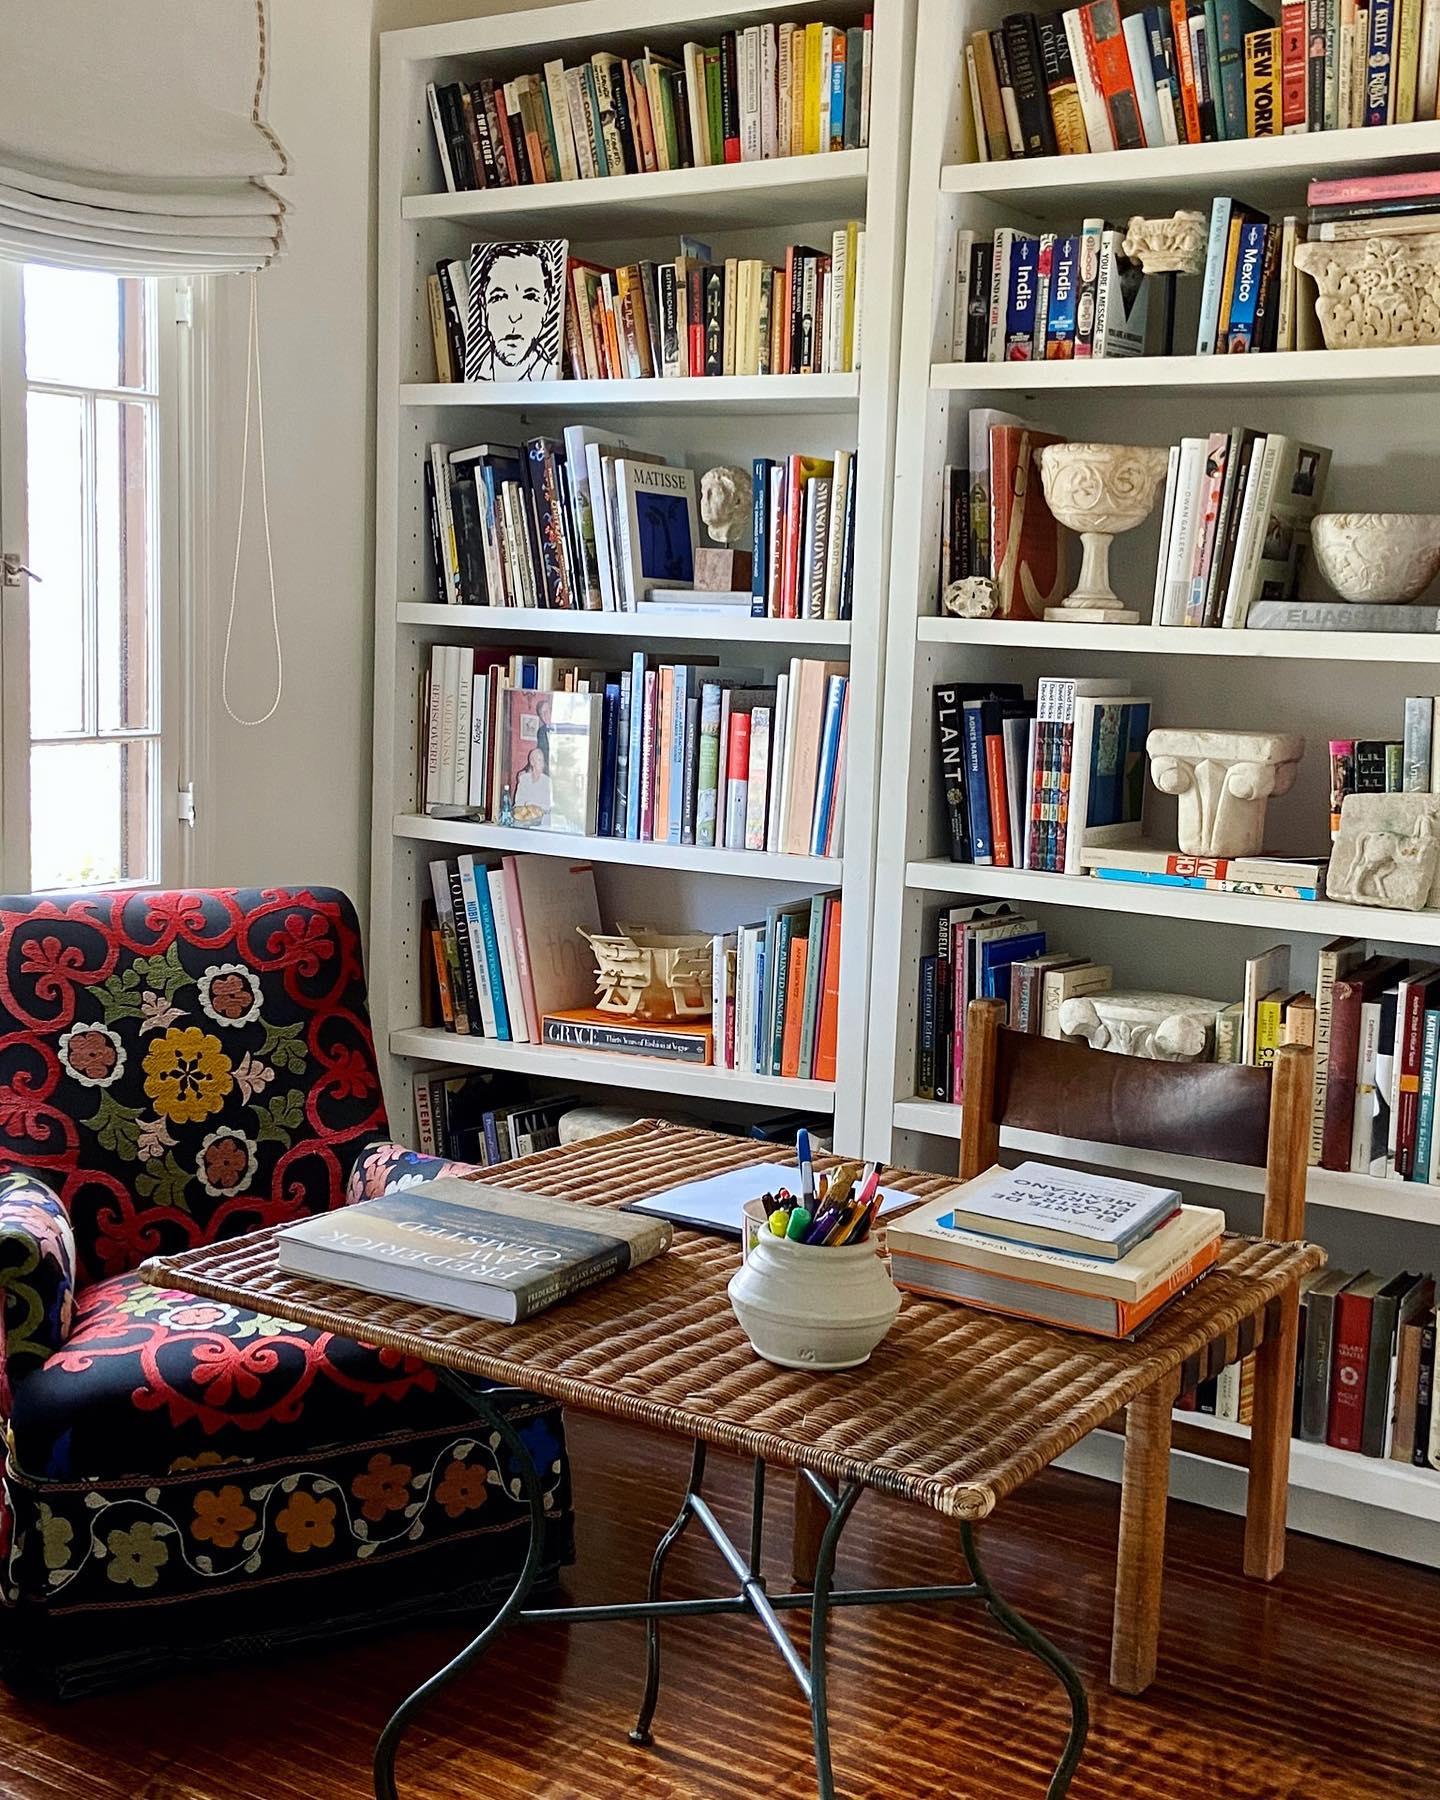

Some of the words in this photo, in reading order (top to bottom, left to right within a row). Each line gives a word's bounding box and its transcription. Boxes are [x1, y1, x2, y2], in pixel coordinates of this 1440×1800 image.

[1374, 8, 1388, 48] KELLEY
[1040, 24, 1060, 74] FOLLETT
[1056, 33, 1069, 60] KEN
[1253, 32, 1272, 77] NEW
[832, 65, 842, 94] Nepal
[1368, 71, 1387, 108] ROYALS
[584, 100, 594, 138] GOOD
[1254, 81, 1273, 138] YORK
[476, 113, 488, 137] SWAP
[482, 140, 494, 165] CLUBS
[834, 235, 845, 271] DIANA'S
[995, 250, 1003, 271] THAT
[1101, 253, 1110, 271] YOU
[834, 275, 845, 299] BOYS
[993, 272, 1002, 294] KIND
[1016, 265, 1032, 311] India
[1057, 260, 1073, 301] India
[1100, 272, 1108, 287] ARE
[1239, 248, 1259, 303] Mexico
[1096, 297, 1106, 334] MESSAGE
[633, 468, 687, 490] MATISSE
[815, 482, 828, 539] SWANSON
[1182, 491, 1192, 518] DWAN
[814, 541, 825, 560] ON
[1177, 519, 1189, 560] GALLERY
[811, 561, 824, 618] SWANSON
[459, 680, 469, 722] JULIUS
[1040, 683, 1048, 701] David
[1048, 683, 1056, 701] David
[1057, 684, 1065, 702] David
[1066, 685, 1074, 703] David
[1039, 702, 1047, 719] Hicks
[1047, 702, 1055, 720] Hicks
[1056, 702, 1064, 720] Hicks
[1065, 703, 1073, 721] Hicks
[430, 684, 441, 774] REDISCOVERED
[937, 690, 962, 783] PLANT
[968, 715, 976, 742] AGNES
[457, 724, 467, 784] SHULMAN
[970, 743, 978, 772] MARTIN
[685, 768, 693, 819] PHOTOGRAPHY
[450, 873, 468, 946] LOULOU
[466, 900, 479, 924] HOBIE
[481, 903, 493, 950] MURAKAMI
[487, 951, 500, 1001] VERSAILLES
[938, 918, 948, 958] ISABELLA
[778, 950, 787, 989] PAINTED
[1321, 966, 1332, 993] THE
[925, 963, 934, 1017] American
[775, 990, 785, 1038] MENAGERIE
[1318, 1000, 1332, 1044] ARTIST
[548, 1023, 600, 1046] GRACE
[605, 1034, 622, 1044] Thirty
[925, 1020, 933, 1048] Eden
[1426, 1015, 1437, 1055] KATHRYN
[1317, 1051, 1328, 1066] IN
[1425, 1057, 1434, 1068] AT
[1315, 1071, 1327, 1094] HIS
[1423, 1070, 1433, 1096] HOME
[417, 1087, 432, 1143] INTENTS
[1312, 1098, 1325, 1152] STUDIO
[989, 1192, 1022, 1203] DE
[1011, 1190, 1124, 1218] MOSTRAR
[1013, 1179, 1137, 1208] MEXICANO
[1027, 1200, 1084, 1215] ARTE
[1043, 1191, 1099, 1206] ARTE
[1108, 1203, 1131, 1213] EL
[1094, 1213, 1117, 1224] EL
[319, 1230, 521, 1281] FREDERICK
[398, 1221, 562, 1262] OLMSTED
[457, 1249, 541, 1271] LAW
